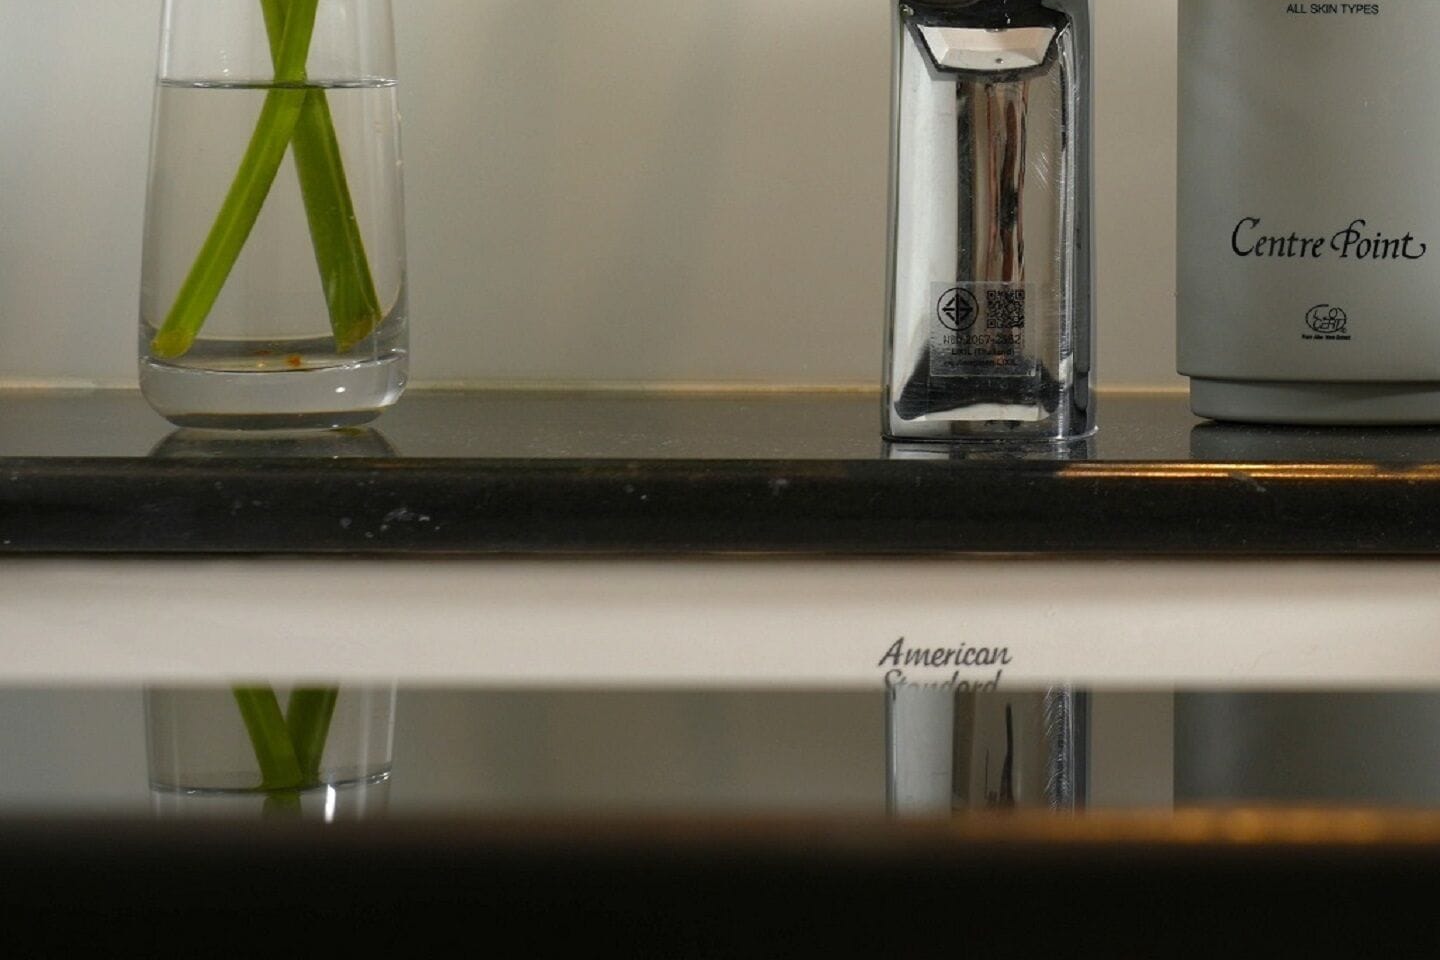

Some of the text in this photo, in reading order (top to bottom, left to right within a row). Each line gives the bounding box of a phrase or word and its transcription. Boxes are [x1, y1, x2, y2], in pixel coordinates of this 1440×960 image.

[1286, 3, 1380, 15] ALL SKIN TYPES
[1231, 216, 1427, 260] Centre Point
[878, 636, 1013, 668] American
